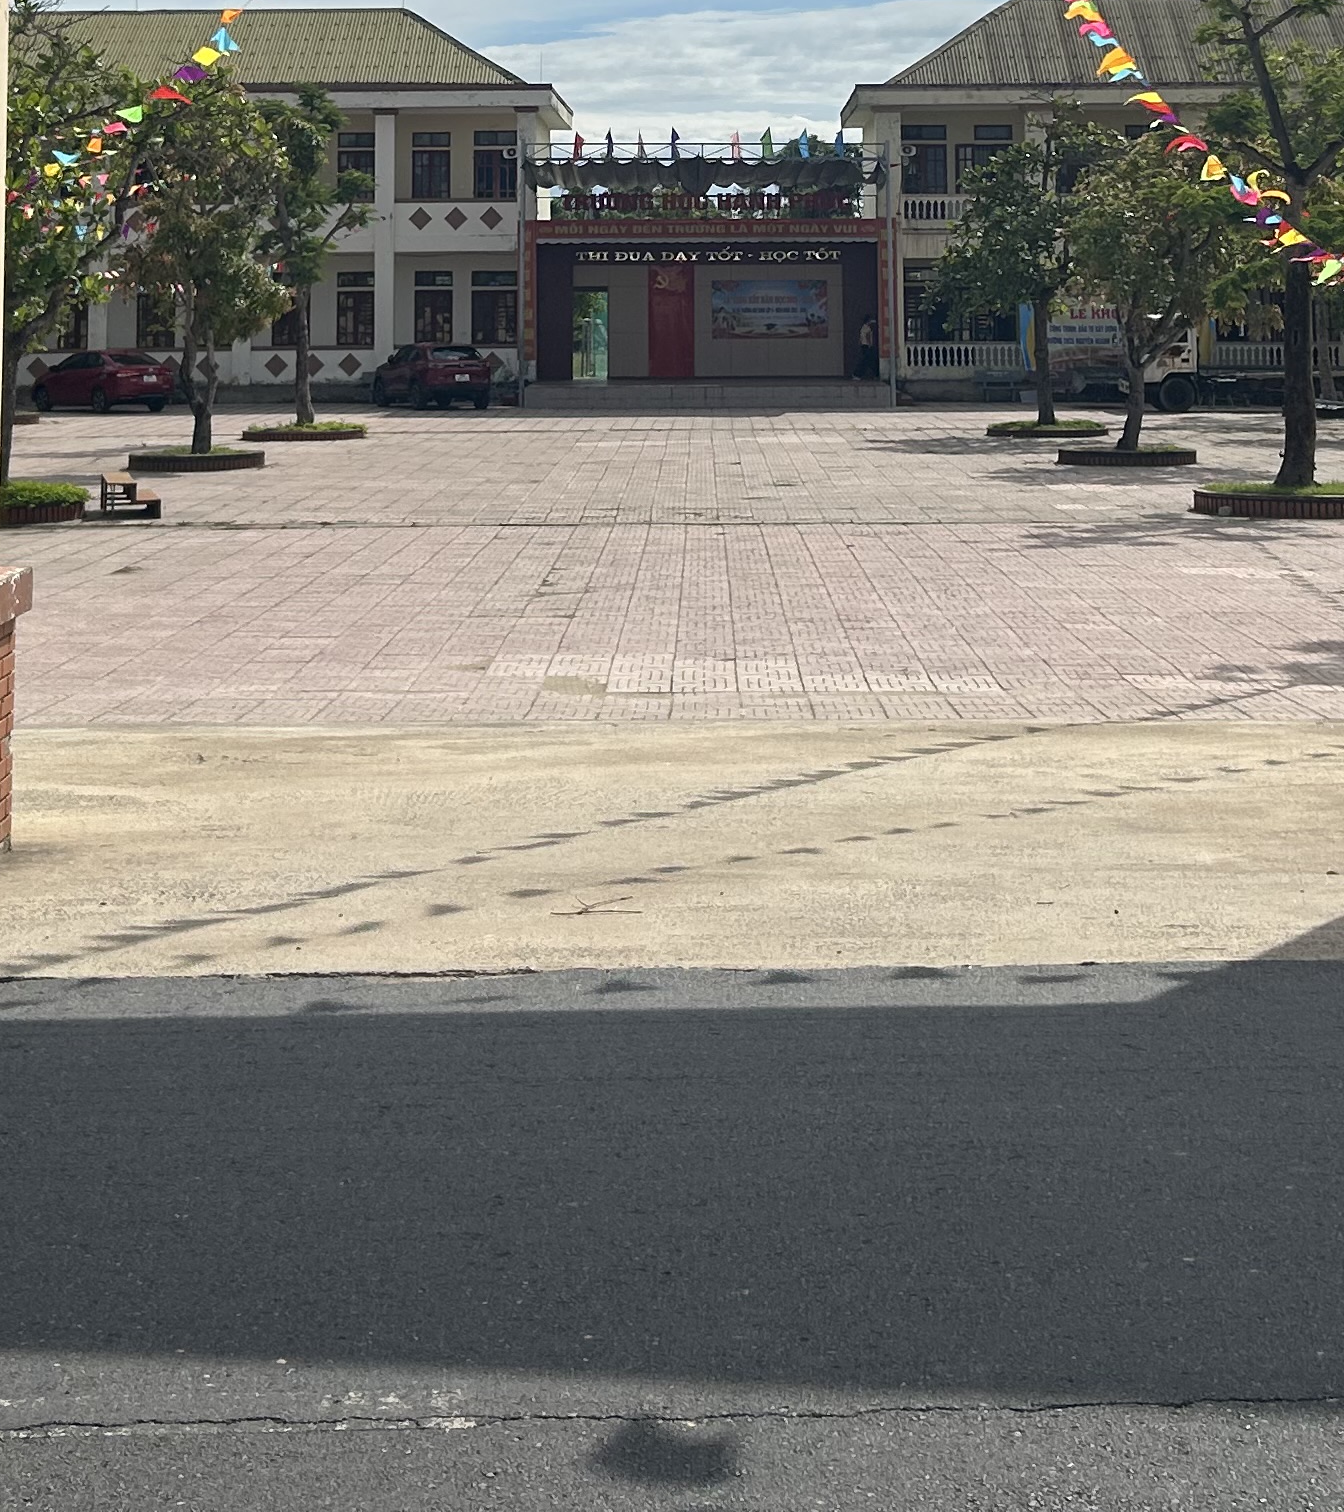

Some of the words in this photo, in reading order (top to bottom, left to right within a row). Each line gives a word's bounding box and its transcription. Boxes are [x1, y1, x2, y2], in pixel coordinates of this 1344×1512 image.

[834, 223, 857, 234] VUI
[576, 251, 609, 262] THI
[614, 251, 656, 262] ĐUA
[661, 251, 701, 264] DẠY
[707, 245, 744, 262] TỐT
[758, 250, 799, 263] HỌC
[803, 245, 842, 261] TỐT
